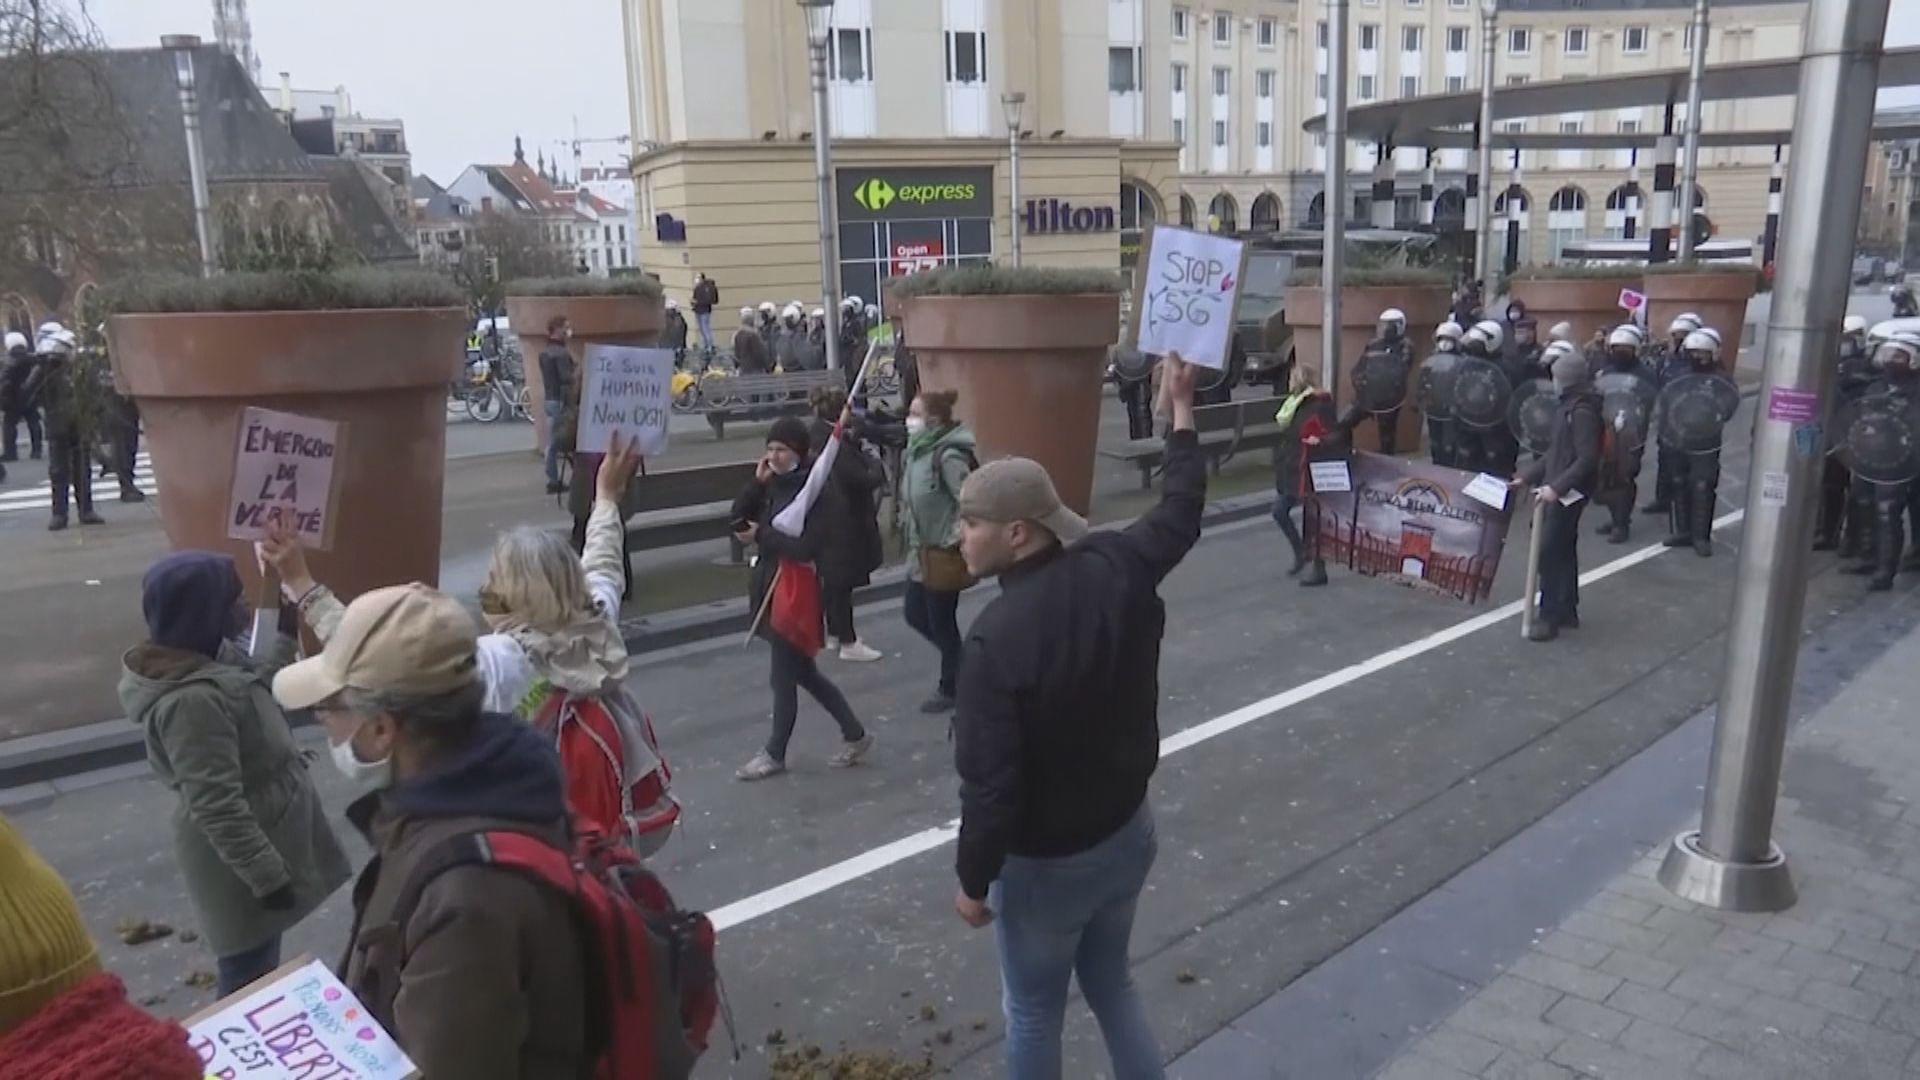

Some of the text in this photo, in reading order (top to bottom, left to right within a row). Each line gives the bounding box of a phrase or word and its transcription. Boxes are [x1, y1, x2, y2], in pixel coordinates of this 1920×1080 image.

[899, 184, 975, 205] express
[897, 246, 929, 259] Open
[1161, 250, 1224, 287] STOP
[1157, 290, 1210, 327] 5G
[259, 474, 298, 503] LA
[218, 1026, 274, 1071] C'EST
[244, 995, 363, 1080] LIBERT
